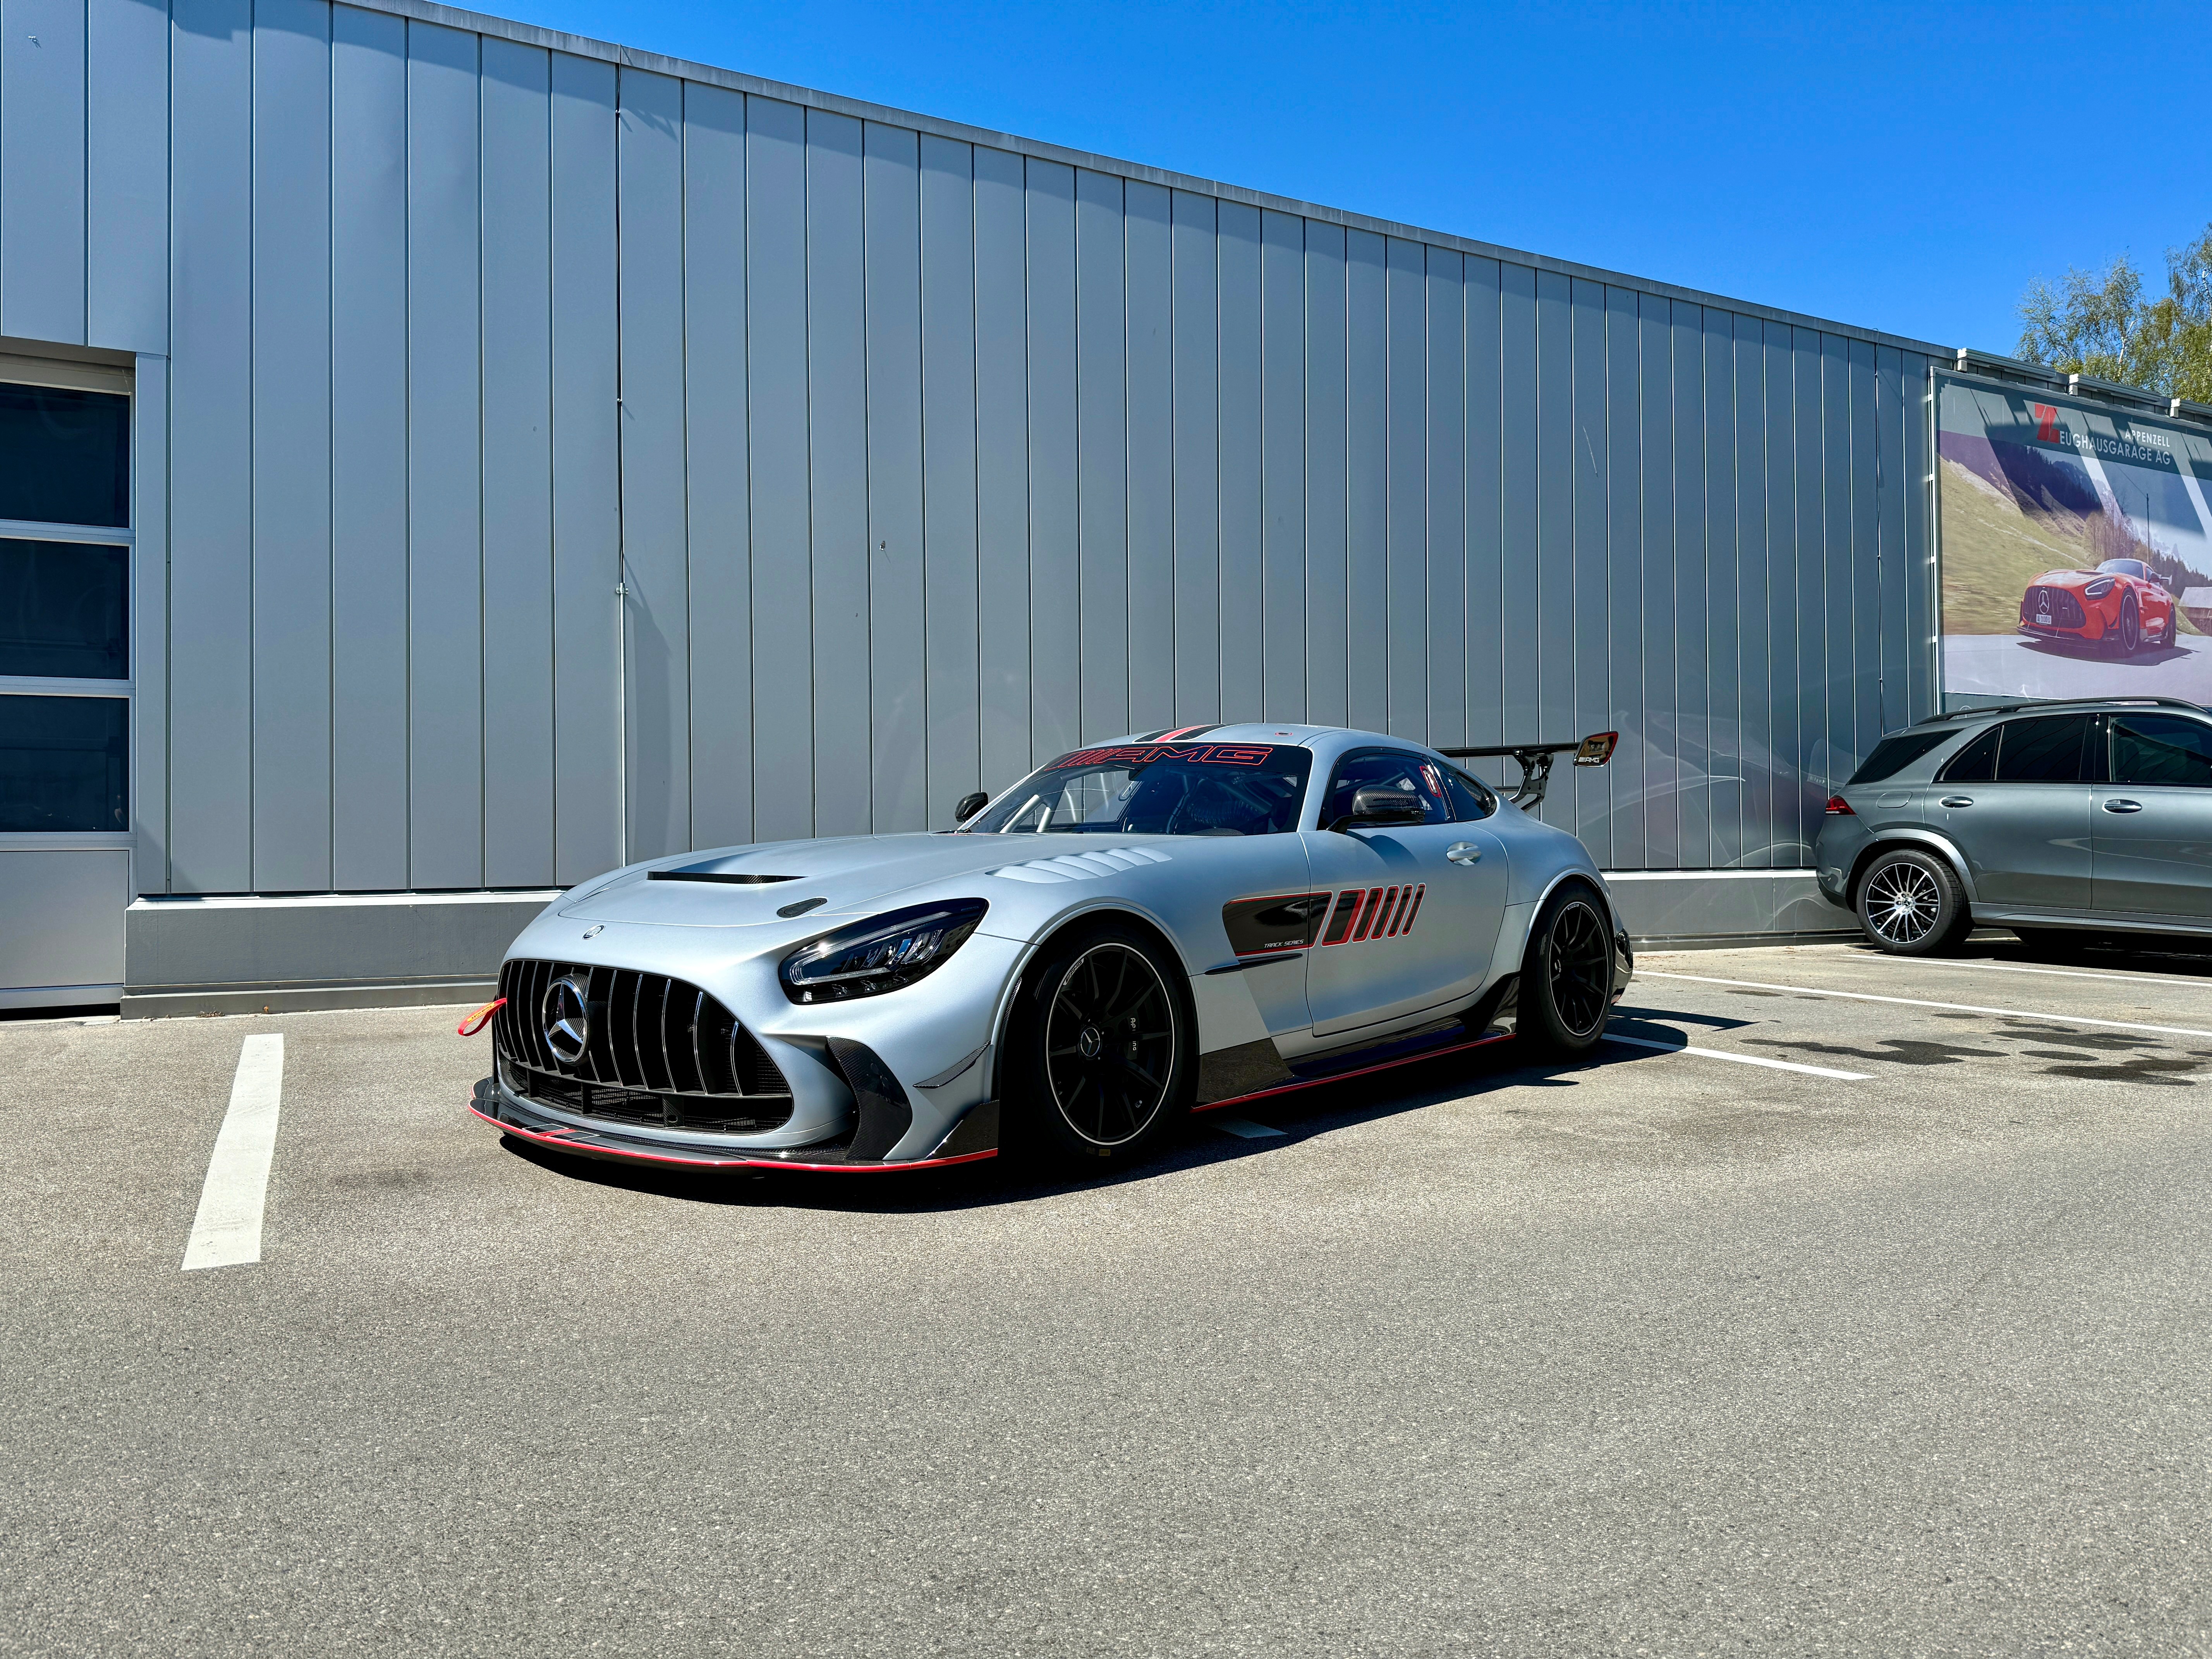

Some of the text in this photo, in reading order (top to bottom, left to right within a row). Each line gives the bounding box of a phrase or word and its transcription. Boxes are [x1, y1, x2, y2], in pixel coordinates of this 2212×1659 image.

[2125, 429, 2170, 447] APPENZELL
[2155, 450, 2170, 465] AG
[1093, 745, 1273, 766] AMG
